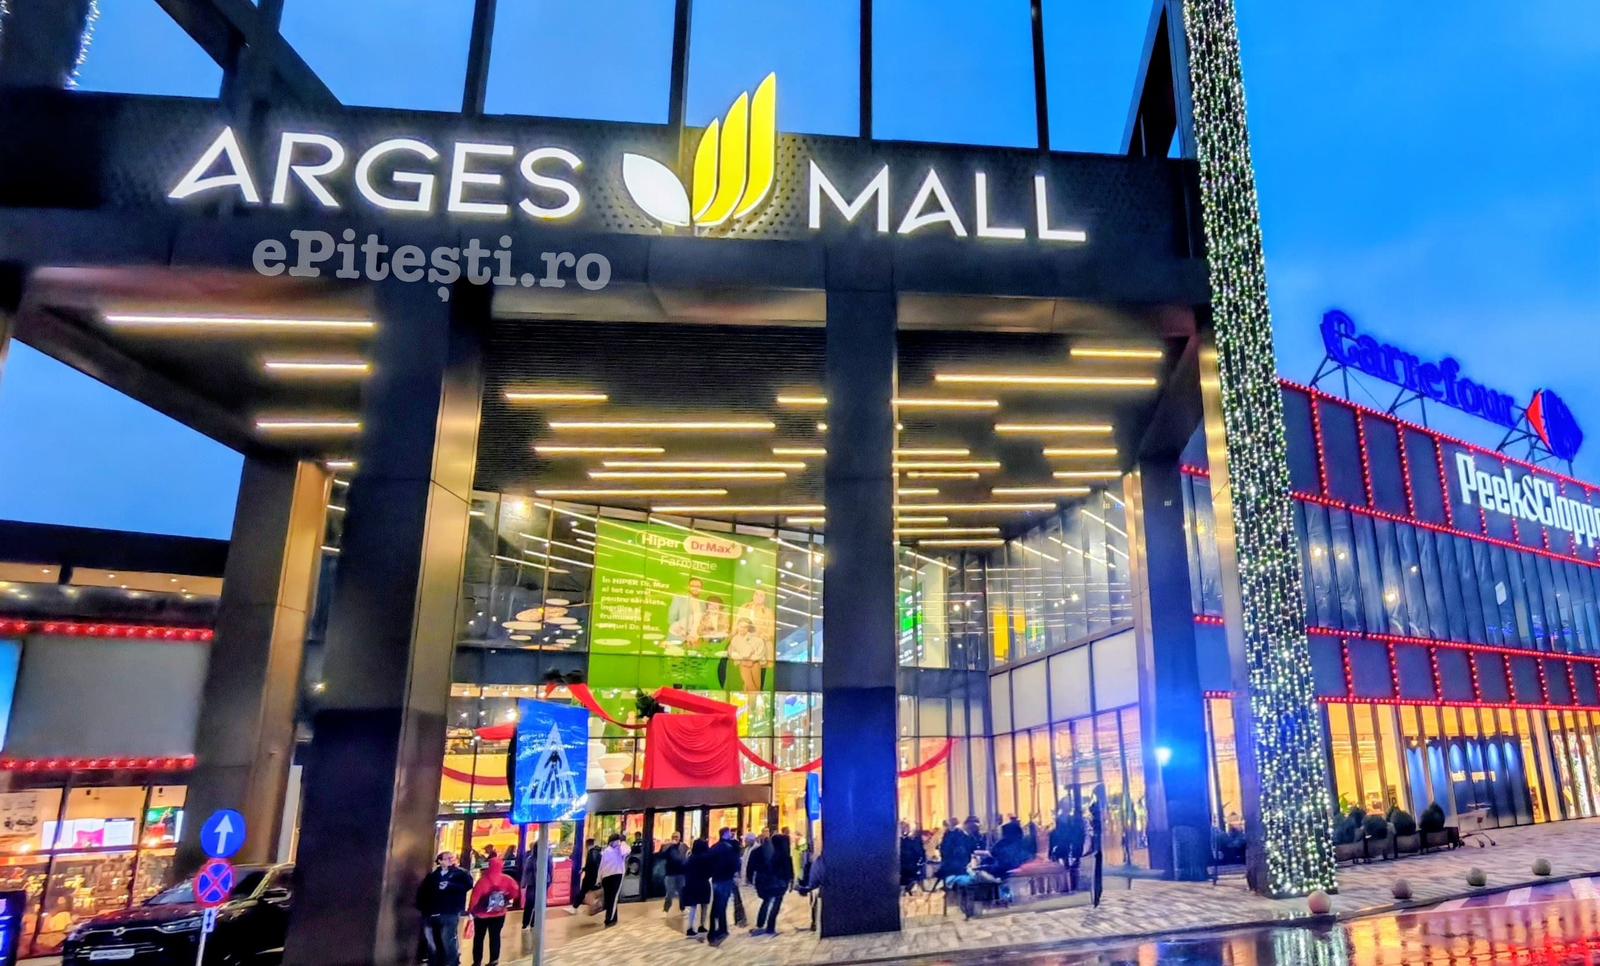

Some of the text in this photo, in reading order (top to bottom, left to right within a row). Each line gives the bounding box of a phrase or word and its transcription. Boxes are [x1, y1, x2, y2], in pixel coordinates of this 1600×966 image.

[168, 125, 1086, 242] ARGES MALL
[1320, 310, 1516, 430] Carrefour
[641, 532, 679, 549] Hiper
